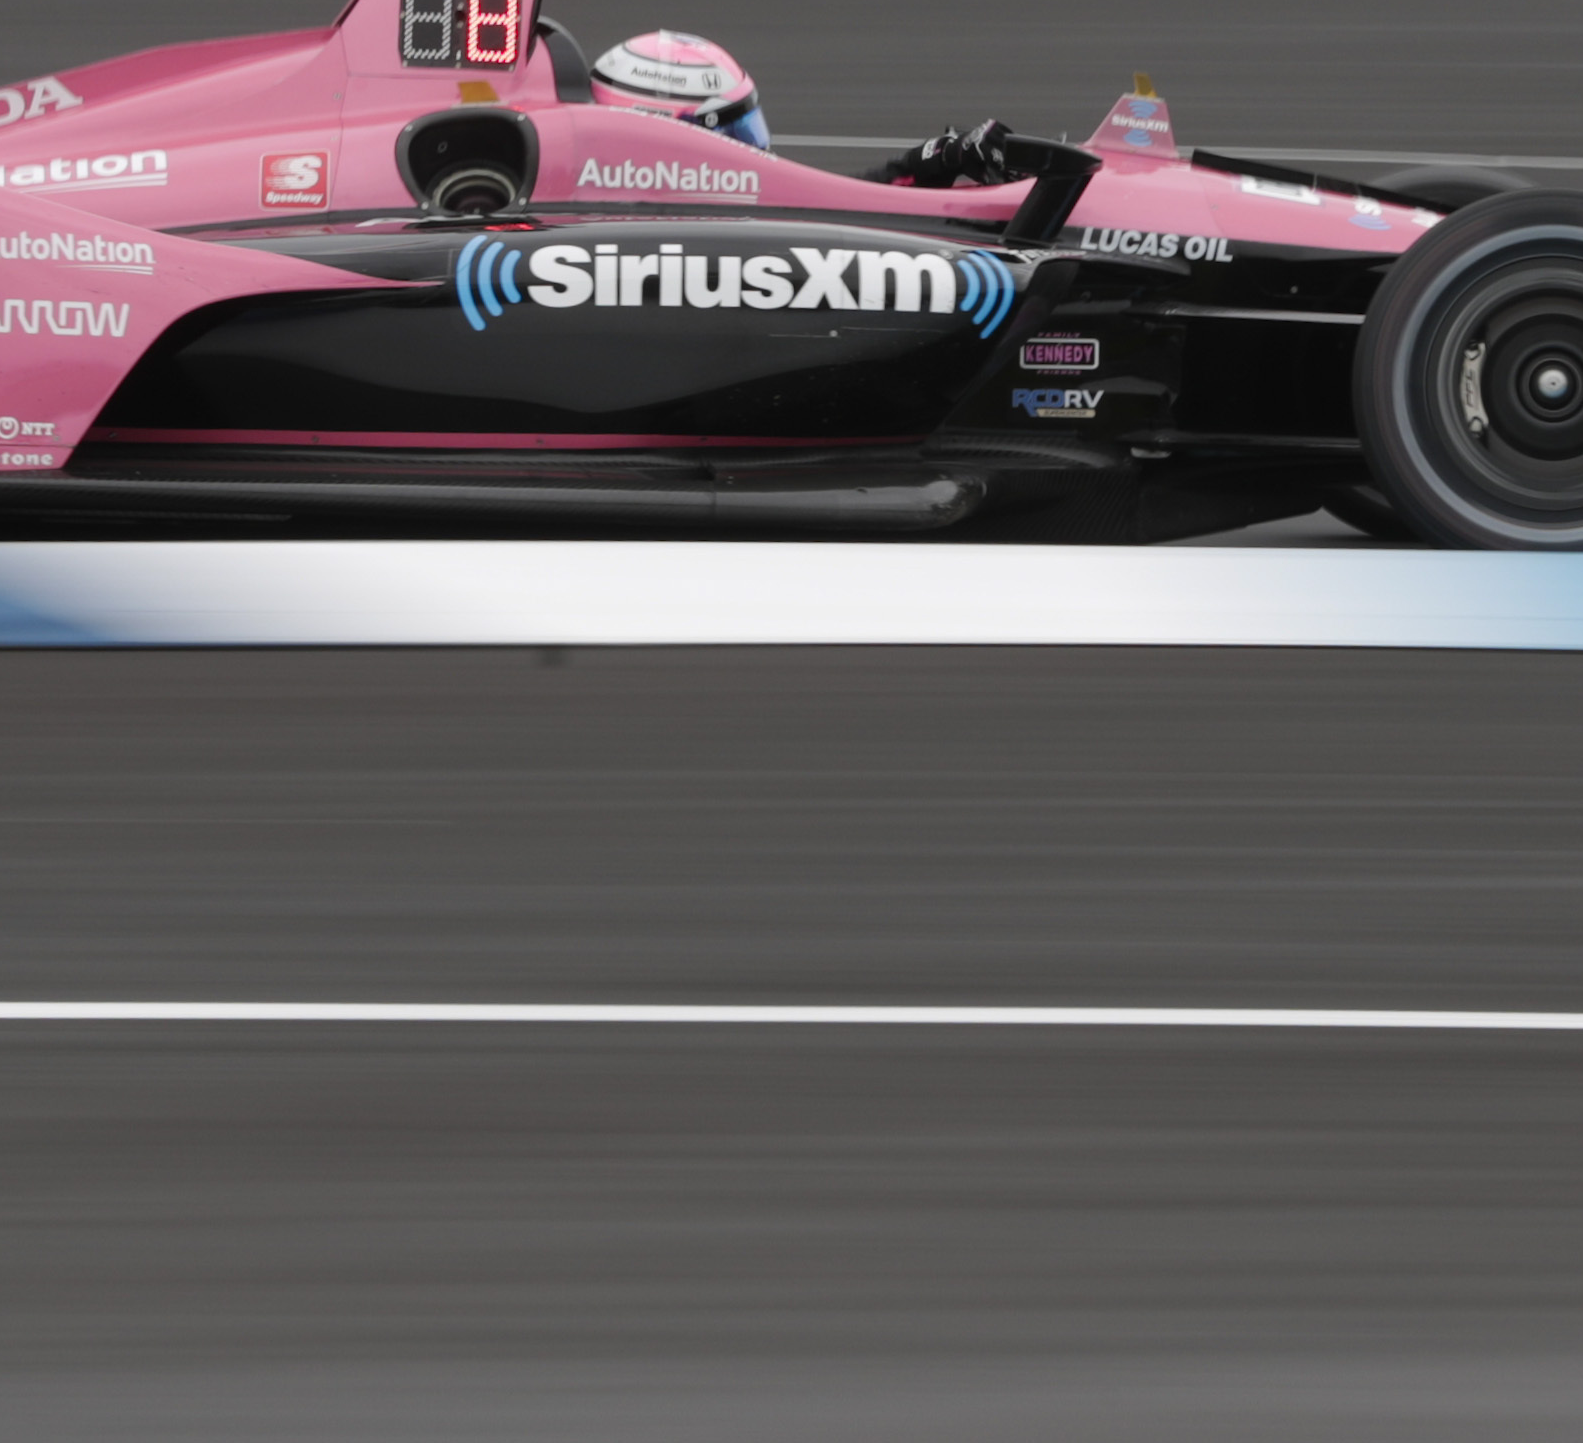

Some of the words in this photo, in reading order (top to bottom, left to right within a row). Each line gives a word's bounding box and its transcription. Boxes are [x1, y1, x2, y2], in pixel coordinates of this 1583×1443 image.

[631, 67, 687, 86] AutoNation
[577, 158, 761, 193] AutoNation
[266, 191, 323, 205] Speedway
[1080, 227, 1179, 258] LUCAS
[1184, 236, 1233, 262] OIL
[1025, 345, 1094, 363] KENNEDY
[21, 422, 55, 436] NTT
